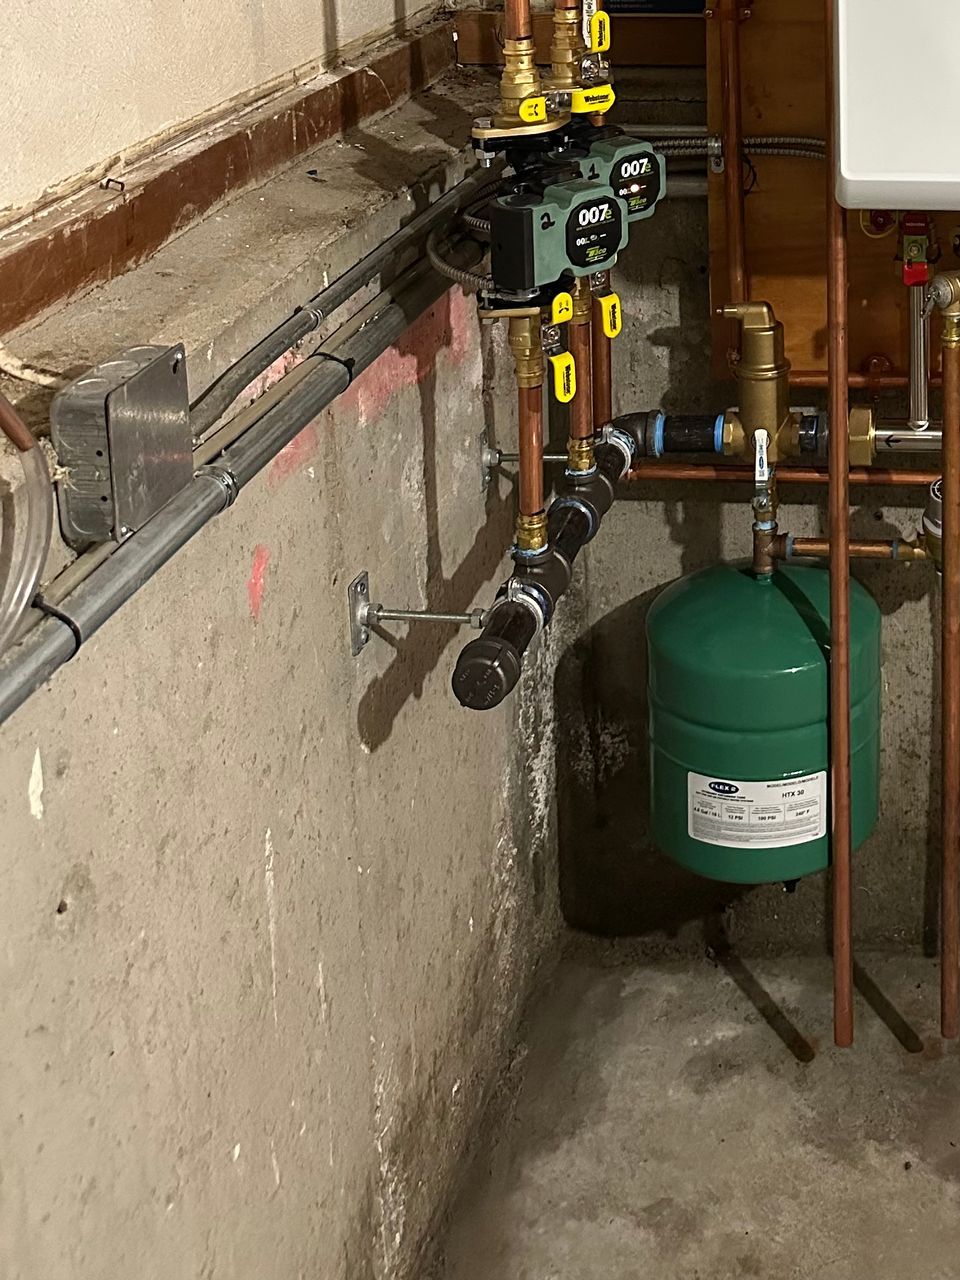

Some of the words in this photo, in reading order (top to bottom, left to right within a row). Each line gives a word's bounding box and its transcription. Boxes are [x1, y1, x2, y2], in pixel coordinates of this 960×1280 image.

[583, 93, 610, 103] Webstone
[588, 164, 600, 180] 1
[540, 212, 555, 230] 2
[711, 783, 730, 791] FLEX
